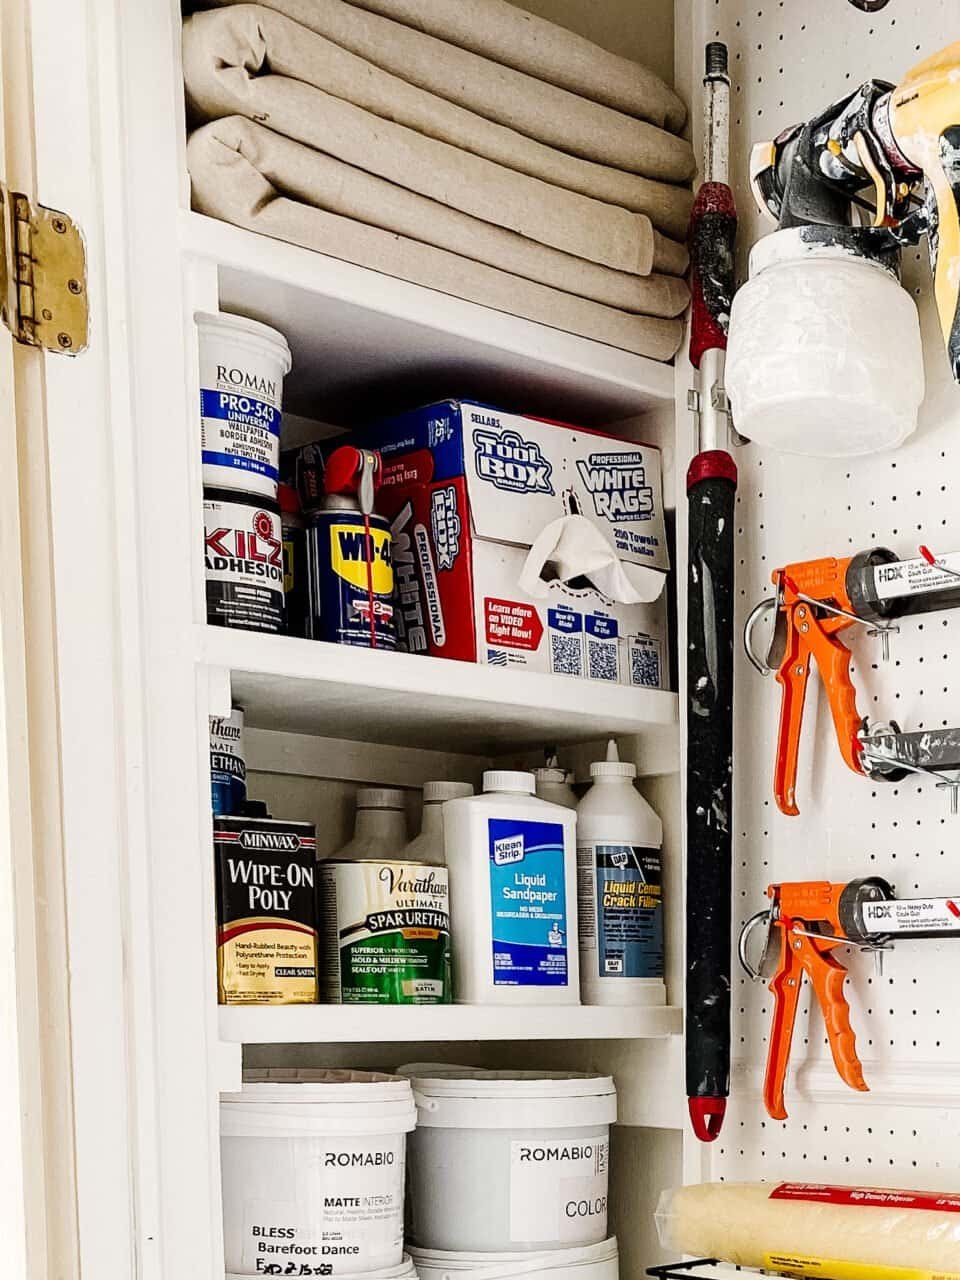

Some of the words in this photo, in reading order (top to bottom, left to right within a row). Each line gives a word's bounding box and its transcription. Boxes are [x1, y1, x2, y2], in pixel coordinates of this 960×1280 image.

[216, 365, 276, 396] ROMAN
[220, 394, 274, 422] PRO-543
[228, 411, 270, 430] UNIVERSAL
[477, 434, 542, 465] TOOL
[592, 454, 642, 466] PROFESSIONAL
[480, 455, 547, 489] BOX
[577, 461, 644, 492] WHITE
[594, 490, 653, 521] RAGS
[205, 526, 282, 569] KILZ
[878, 566, 903, 583] HDX
[416, 531, 444, 642] PROFESSIONAL
[488, 602, 511, 614] Learn
[500, 615, 523, 626] VIDEO
[489, 624, 510, 636] Right
[243, 833, 298, 850] MINWAX
[495, 840, 522, 853] Klean
[499, 850, 520, 862] Strip
[227, 858, 314, 888] WIPE-ON
[514, 872, 546, 889] Liquid
[502, 887, 558, 904] Sandpaper
[604, 880, 636, 895] Liquid
[248, 886, 293, 912] POLY
[396, 900, 442, 910] ULTIMATE
[603, 894, 636, 908] Crack
[867, 906, 892, 919] HDX
[368, 914, 404, 930] SPAR
[276, 968, 296, 976] CLEAR
[324, 1151, 394, 1167] ROMABIO
[520, 1145, 593, 1162] ROMABIO
[324, 1197, 361, 1207] MATTE
[252, 1226, 295, 1239] BLESS
[258, 1242, 318, 1255] Barefoot
[321, 1245, 360, 1255] Dance
